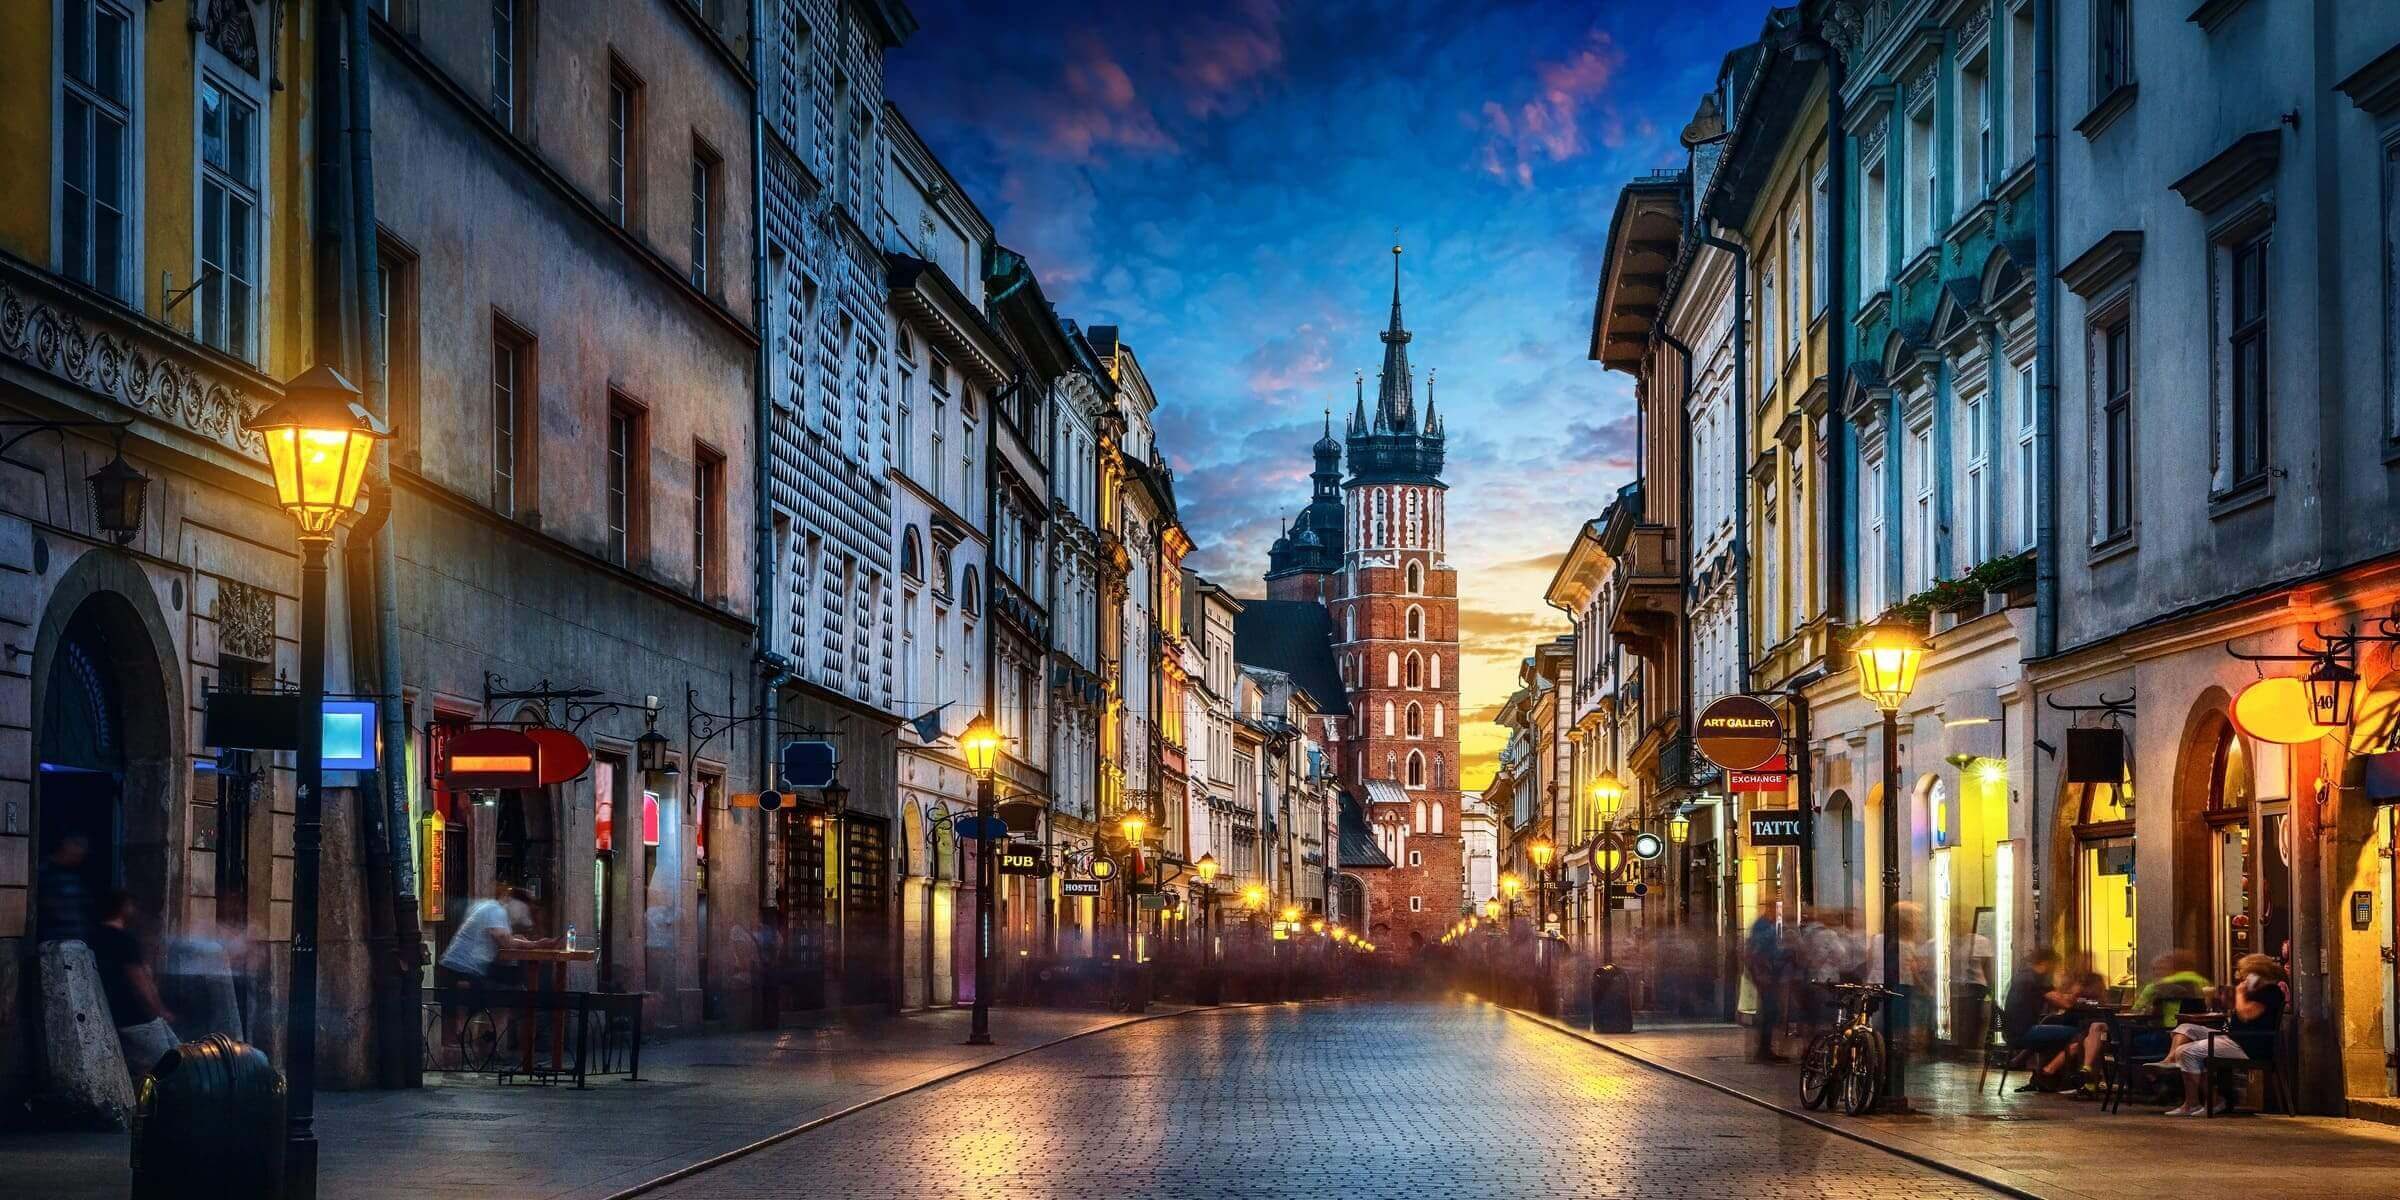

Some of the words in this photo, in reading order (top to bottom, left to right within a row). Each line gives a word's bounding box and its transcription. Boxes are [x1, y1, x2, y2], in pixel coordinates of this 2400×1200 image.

[2317, 695, 2334, 709] 40
[1703, 718, 1725, 727] ART
[1727, 718, 1775, 728] GALLERY
[1732, 775, 1782, 784] EXCHANGE
[1003, 855, 1034, 867] PUB
[1065, 884, 1098, 892] HOSTEL
